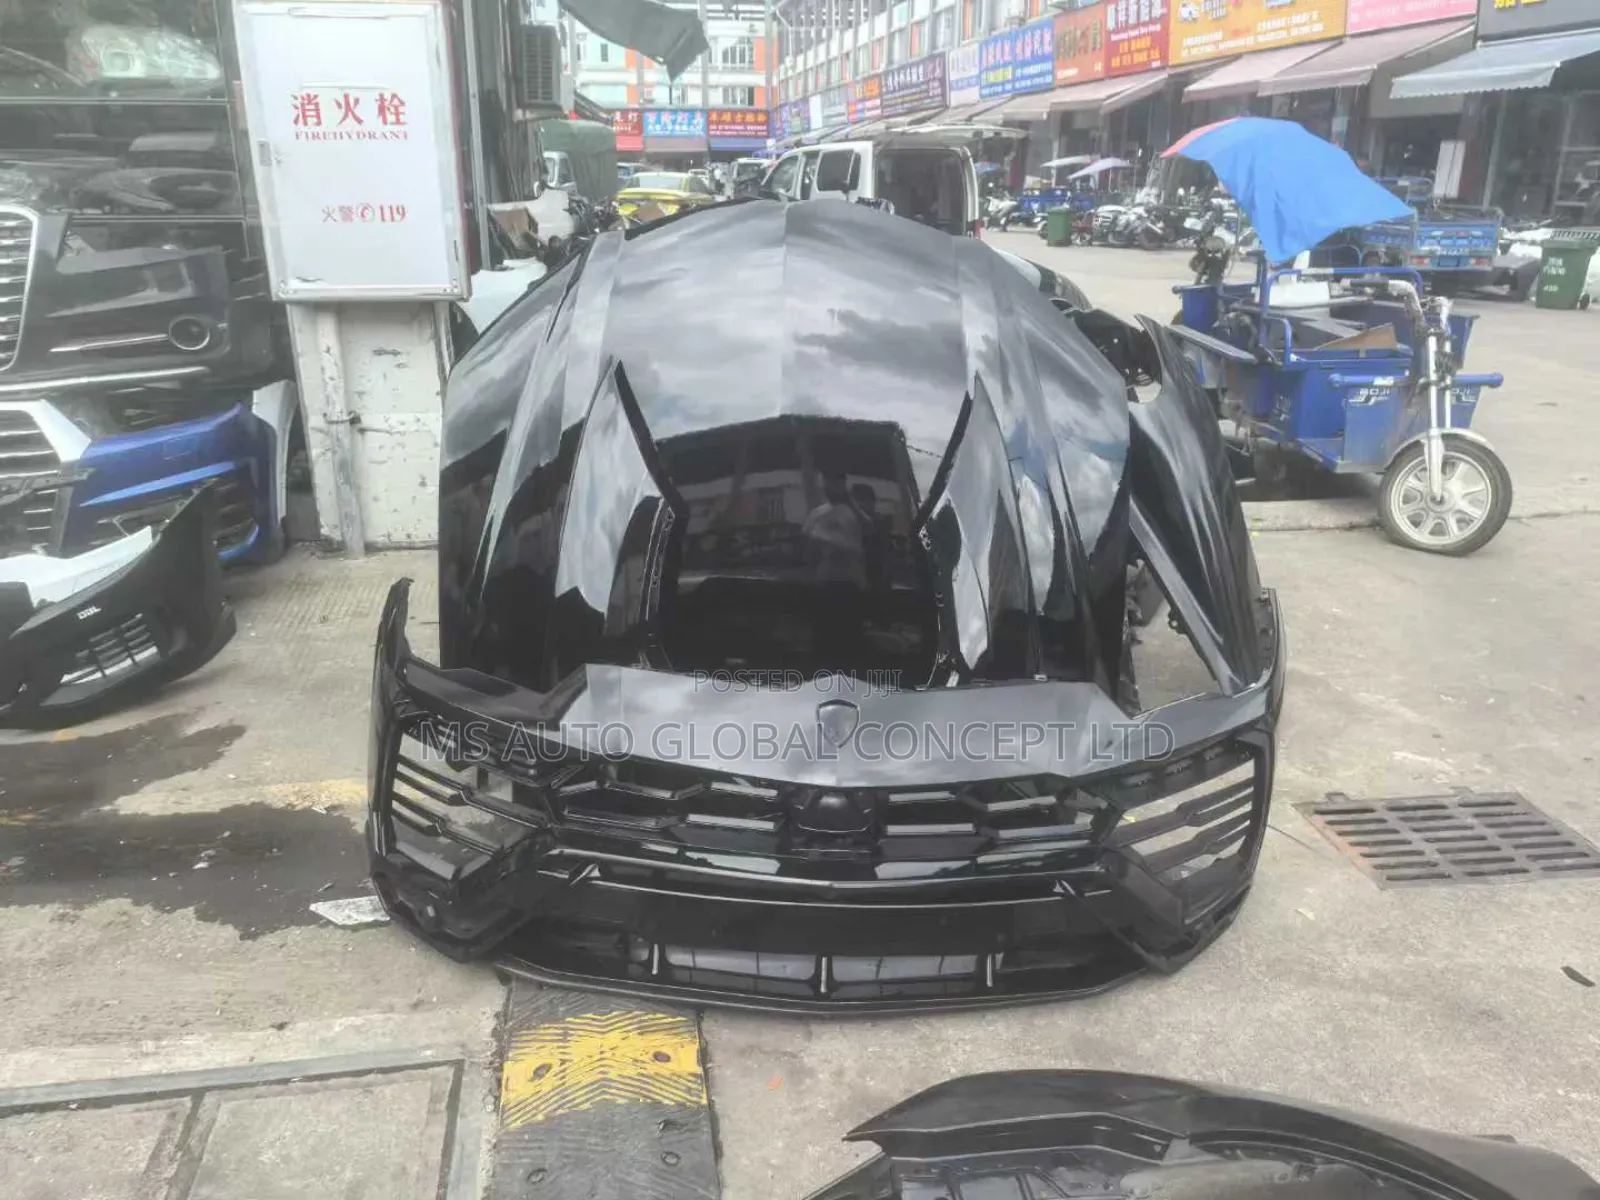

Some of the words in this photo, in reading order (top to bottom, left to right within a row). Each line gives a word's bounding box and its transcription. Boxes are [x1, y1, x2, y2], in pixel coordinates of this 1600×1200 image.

[291, 92, 408, 126] 消火栓
[294, 130, 408, 140] FIREHYDRANT
[379, 203, 406, 222] 119
